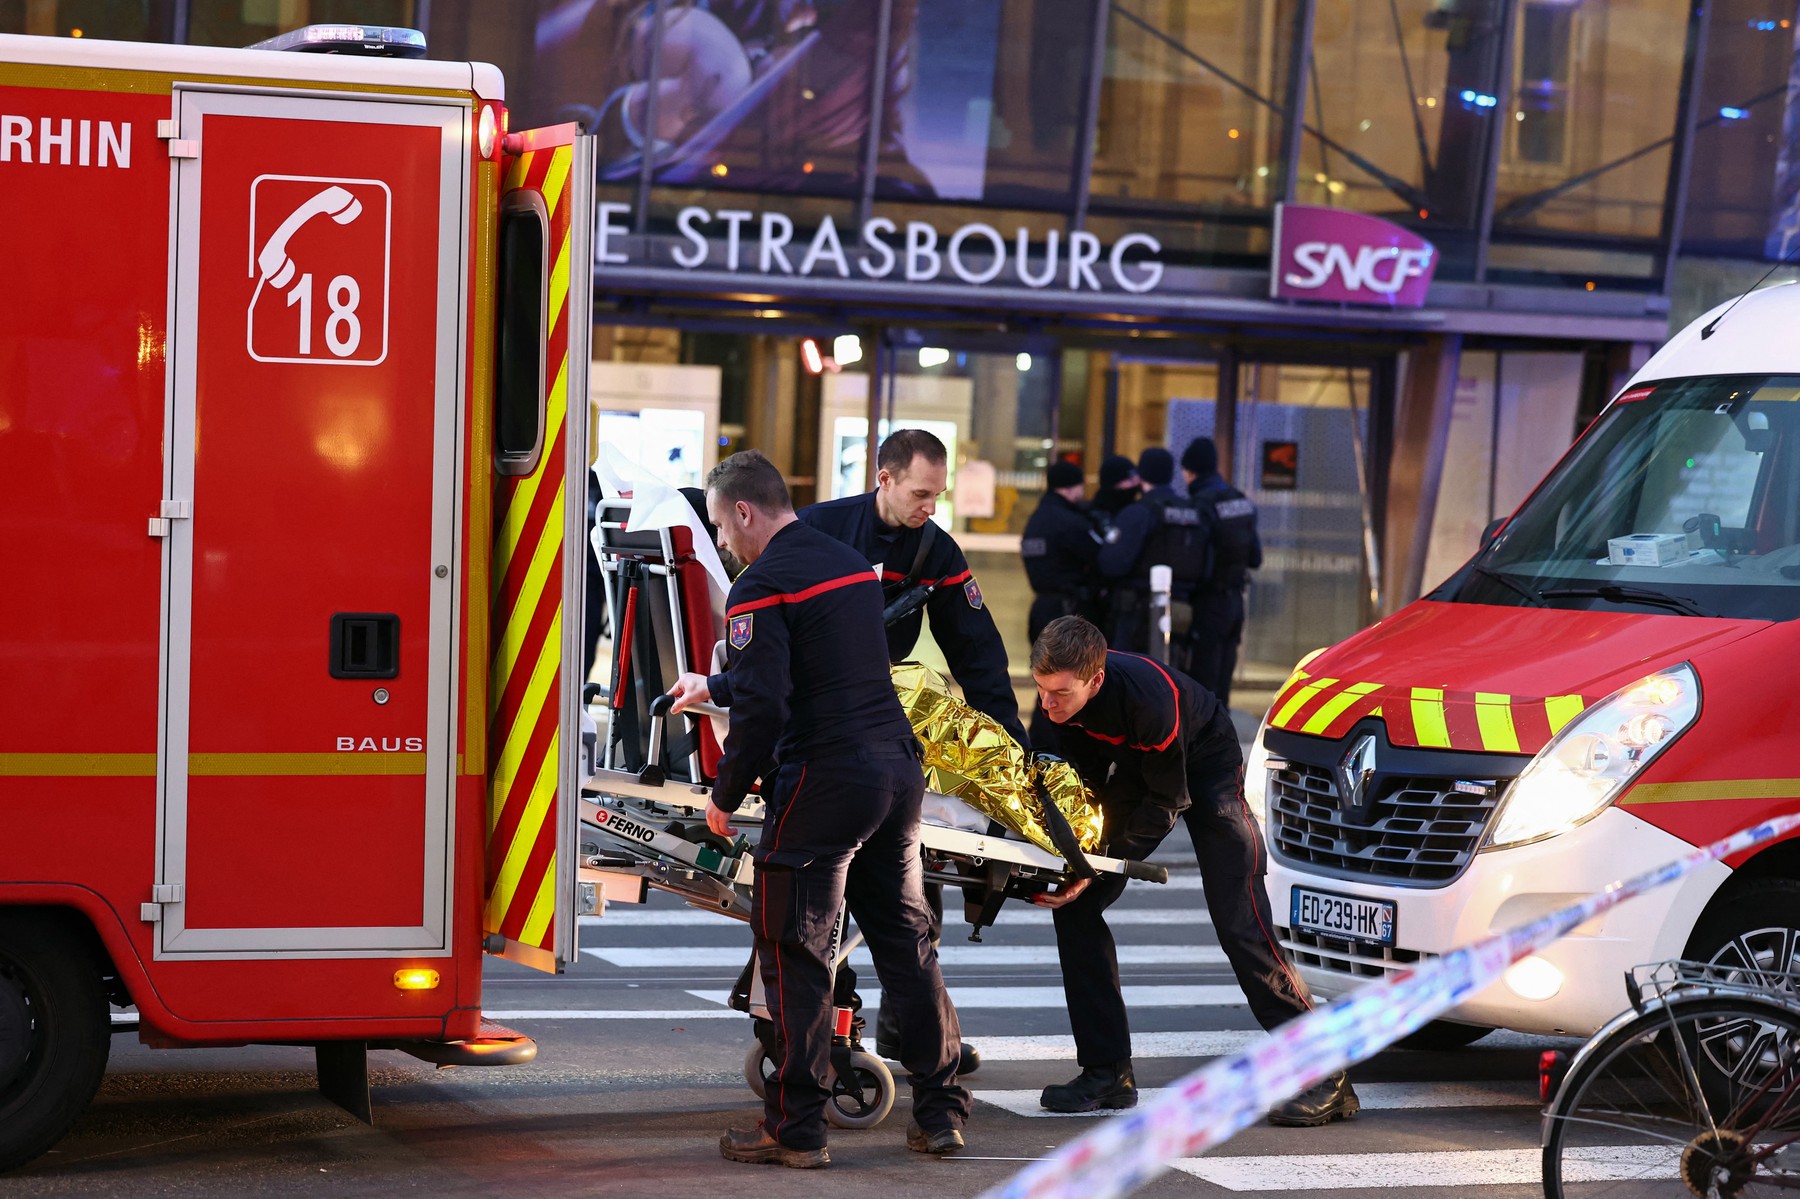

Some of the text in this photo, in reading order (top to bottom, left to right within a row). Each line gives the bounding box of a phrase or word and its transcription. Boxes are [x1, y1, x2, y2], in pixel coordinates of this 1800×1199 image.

[0, 115, 132, 168] RHIN
[671, 206, 1164, 293] STRASBOURG
[1285, 242, 1433, 294] SNCF
[287, 273, 361, 357] 18
[336, 736, 423, 752] BAUS
[606, 814, 656, 842] FERNO
[1301, 894, 1379, 935] ED-239-HK
[1382, 923, 1393, 938] 67
